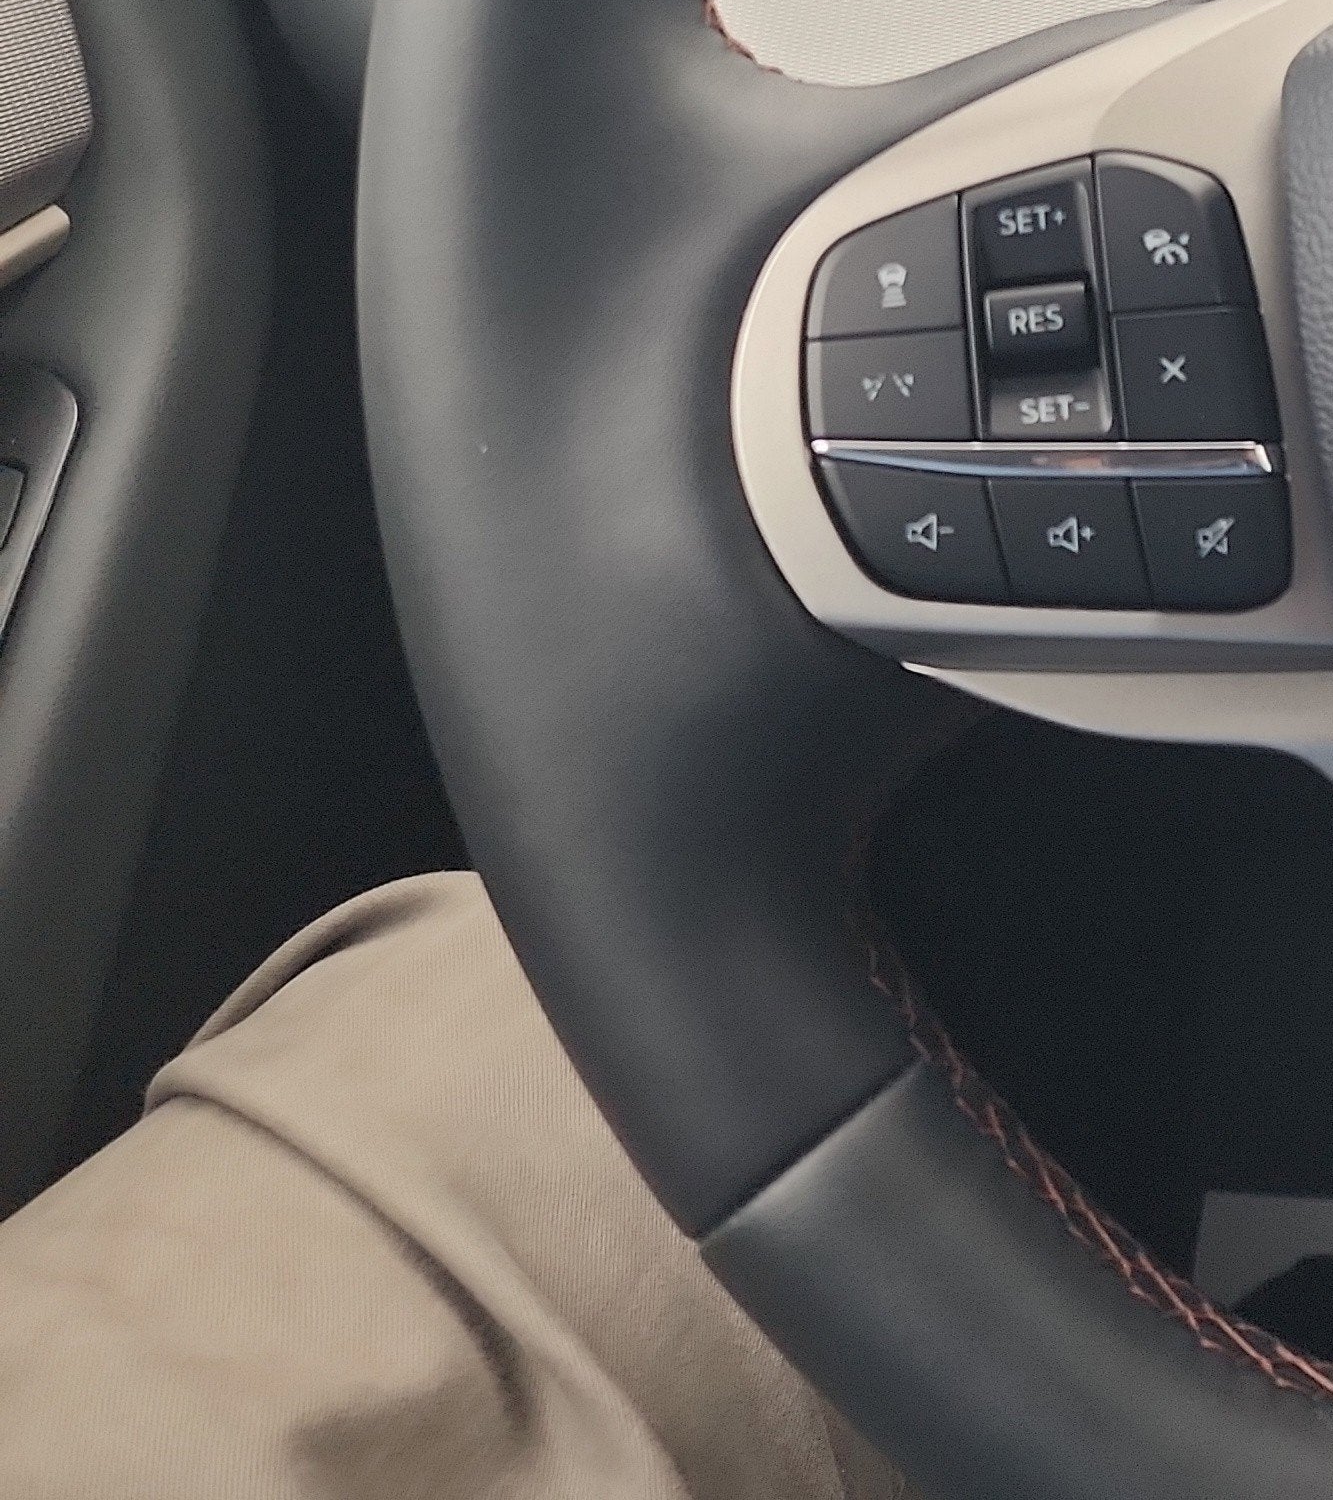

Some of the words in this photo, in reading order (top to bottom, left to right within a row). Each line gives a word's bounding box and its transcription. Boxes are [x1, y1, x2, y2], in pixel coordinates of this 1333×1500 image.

[999, 204, 1067, 236] SET+
[1007, 304, 1064, 335] RES
[1018, 394, 1090, 425] SET-
